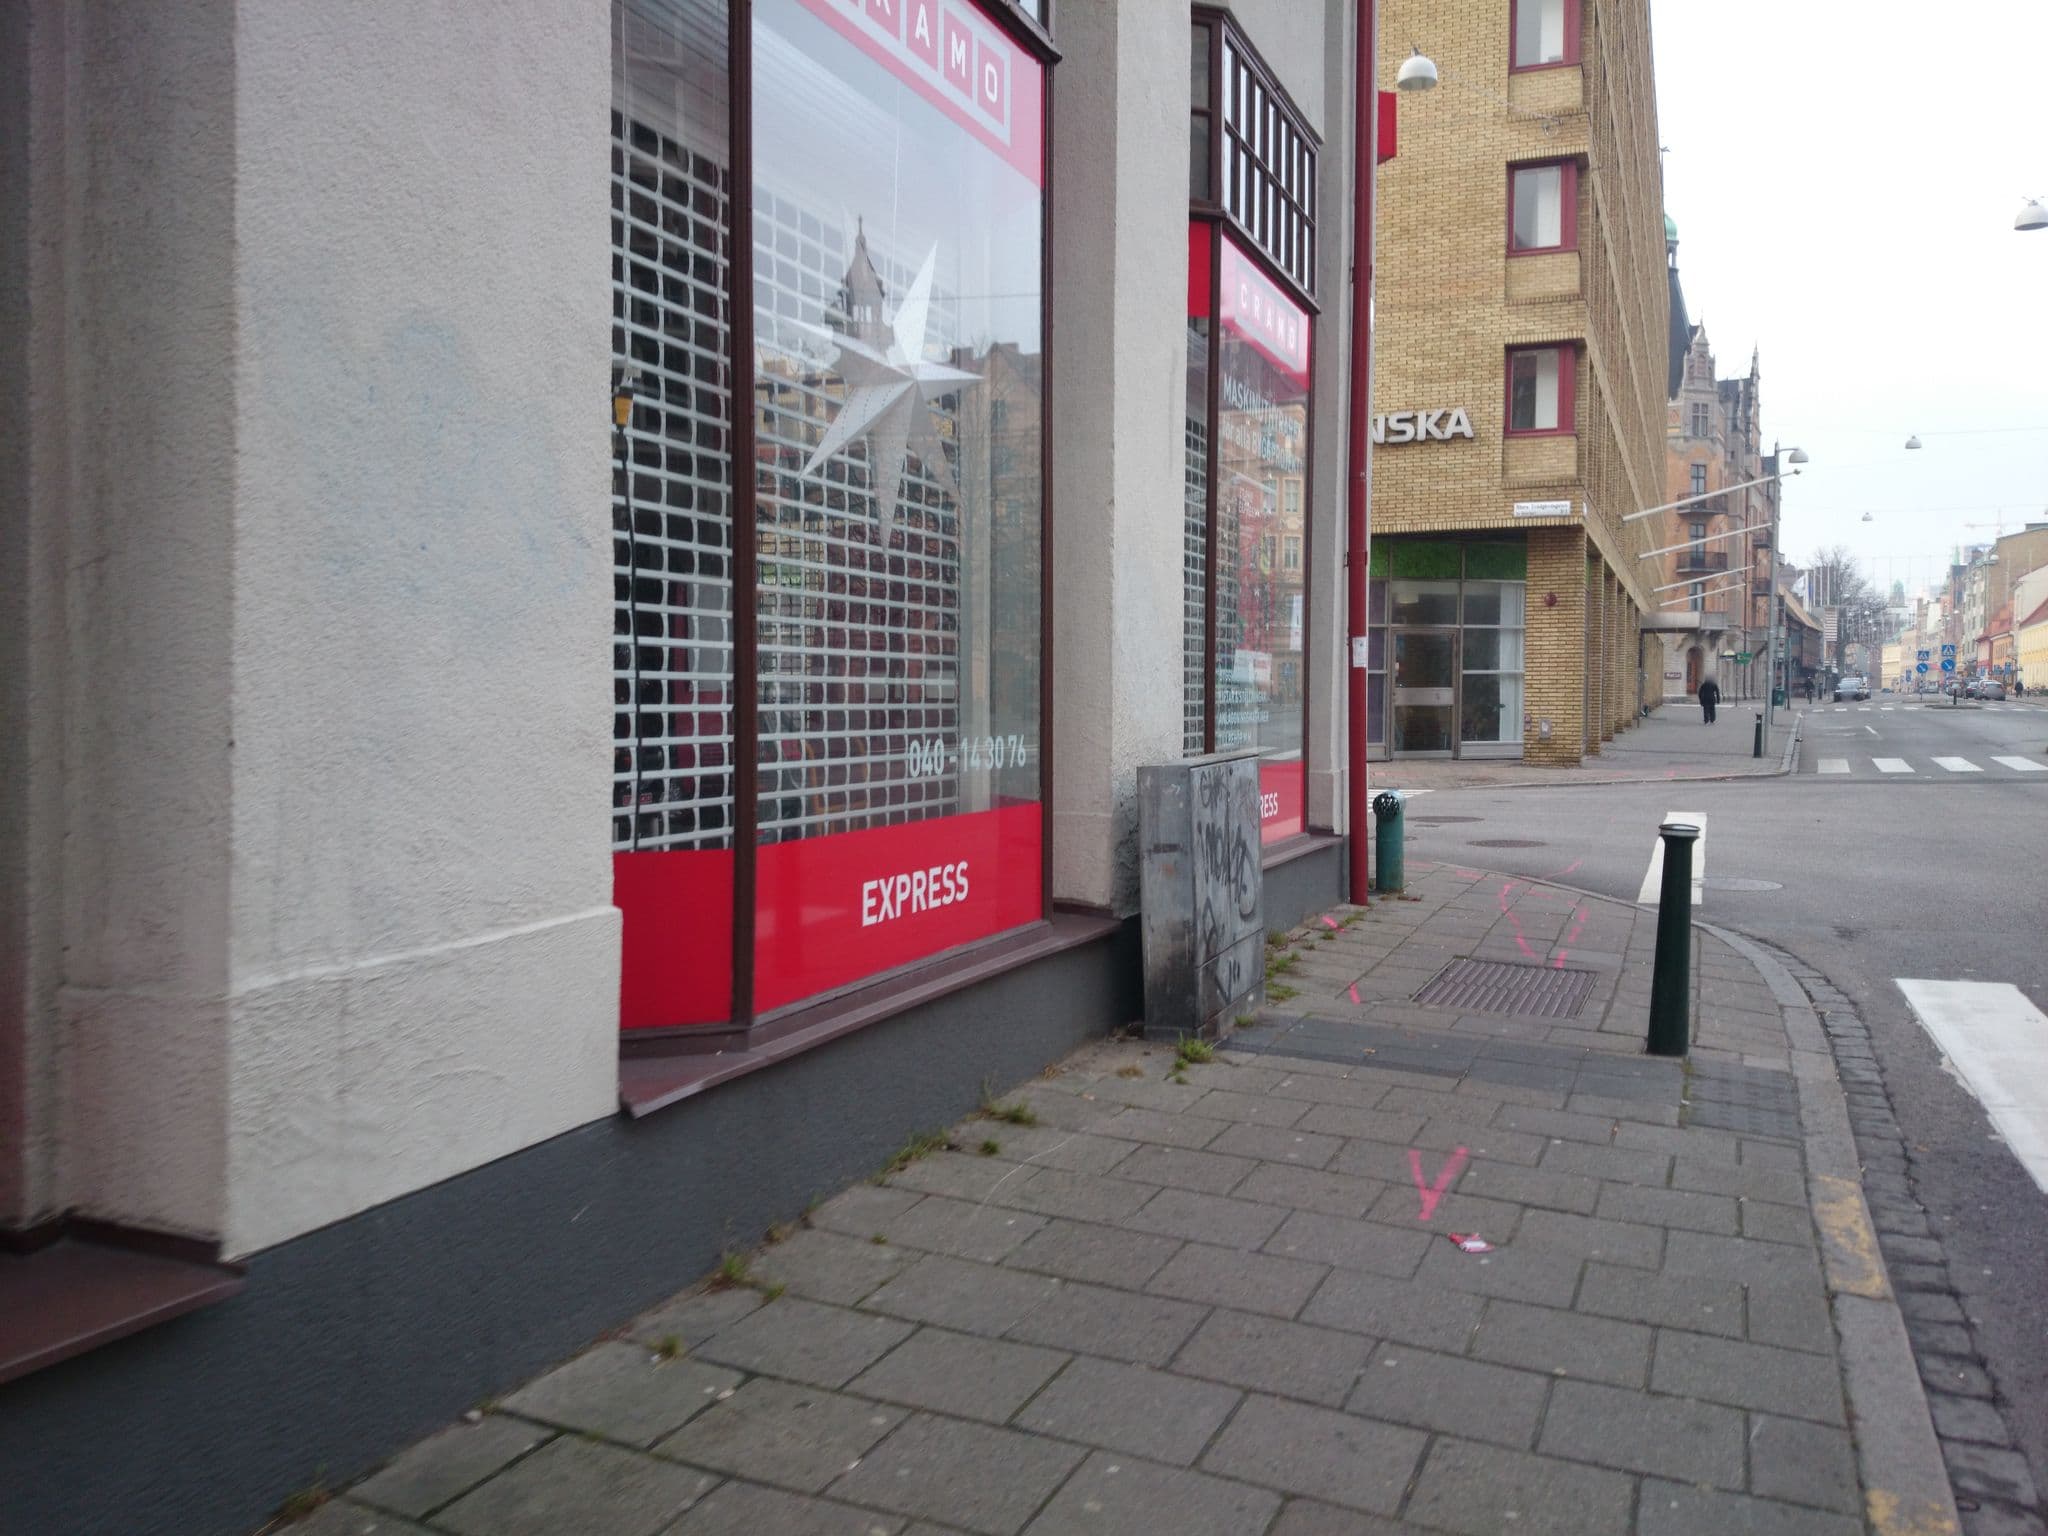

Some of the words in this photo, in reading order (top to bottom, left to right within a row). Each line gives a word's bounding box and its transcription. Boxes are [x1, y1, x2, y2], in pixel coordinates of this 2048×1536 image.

[1240, 283, 1296, 351] CRAMO
[908, 738, 945, 778] 040
[861, 860, 970, 928] EXPRESS
